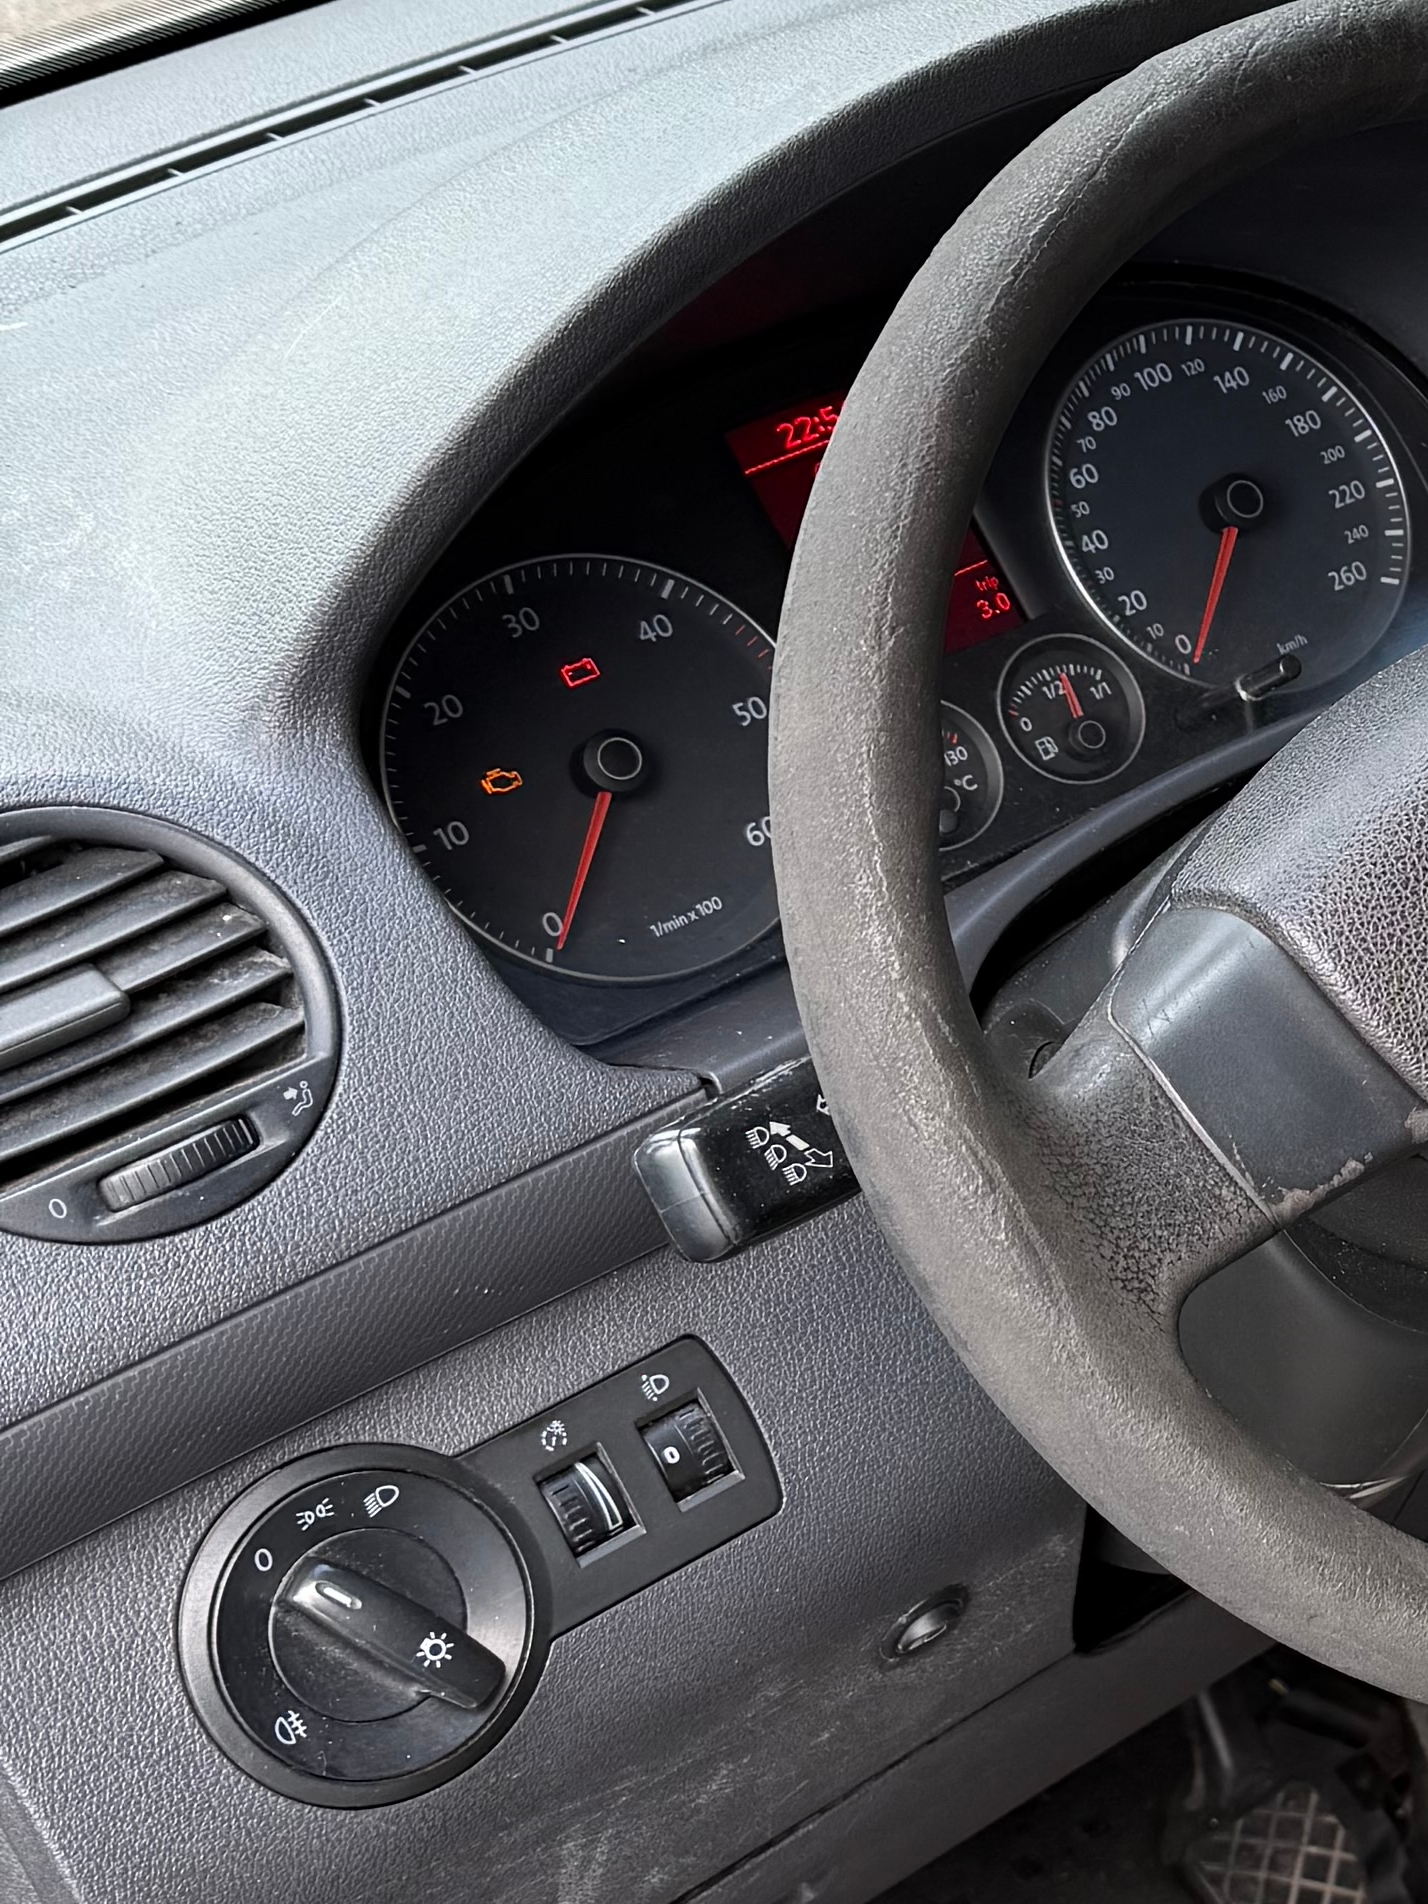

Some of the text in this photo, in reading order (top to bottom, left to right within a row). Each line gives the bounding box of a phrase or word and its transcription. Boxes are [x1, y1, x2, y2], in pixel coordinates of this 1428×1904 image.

[1135, 362, 1173, 392] 100
[1181, 358, 1205, 378] 120
[1213, 366, 1250, 394] 140
[1110, 383, 1131, 401] 90
[1262, 385, 1288, 405] 160
[776, 405, 840, 448] 22:5
[1087, 406, 1118, 432] 80
[1285, 409, 1322, 437] 180
[1076, 436, 1097, 454] 70
[1320, 445, 1346, 465] 200
[1069, 463, 1099, 489] 60
[1328, 480, 1366, 509] 220
[1071, 501, 1090, 519] 50
[1081, 529, 1109, 554] 40
[1344, 524, 1370, 544] 240
[975, 576, 999, 591] trip
[1095, 566, 1115, 585] 30
[1328, 561, 1367, 591] 260
[976, 592, 1010, 619] 3.0
[1118, 589, 1148, 616] 20
[502, 607, 540, 638] 30
[638, 614, 673, 643] 40
[1146, 622, 1165, 642] 10
[1174, 634, 1192, 655] 0
[1276, 634, 1308, 656] km/h
[1042, 680, 1067, 700] 1/2
[1090, 682, 1112, 700] 1/1
[424, 694, 464, 726] 20
[732, 696, 768, 726] 50
[1019, 718, 1033, 732] 0
[433, 820, 470, 850] 10
[542, 912, 564, 937] 0
